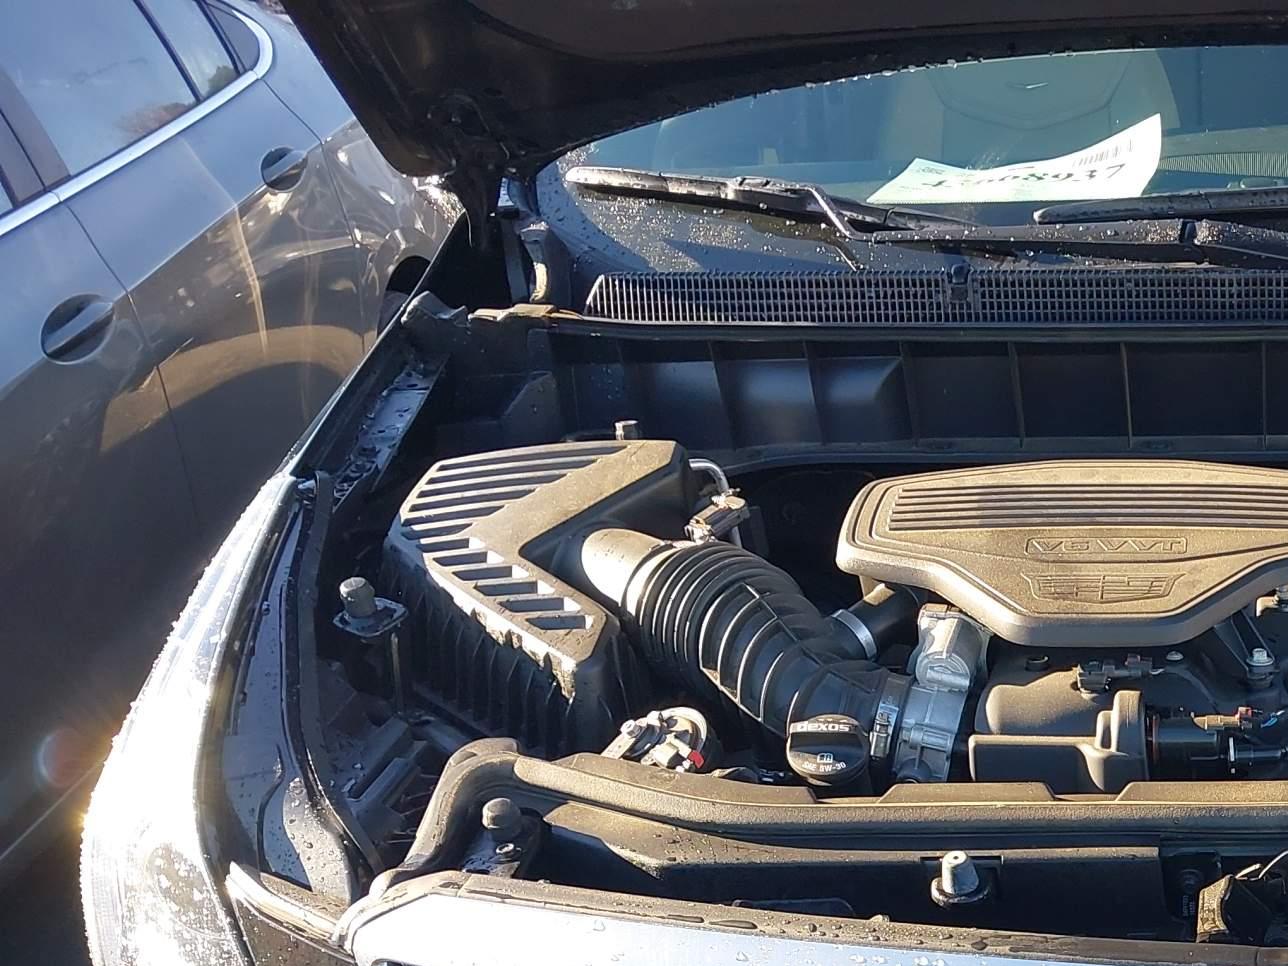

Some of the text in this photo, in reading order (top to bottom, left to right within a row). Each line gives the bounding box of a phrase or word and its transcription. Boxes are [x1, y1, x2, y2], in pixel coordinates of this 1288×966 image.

[1032, 539, 1182, 552] V6 VVT
[796, 722, 850, 732] dexos
